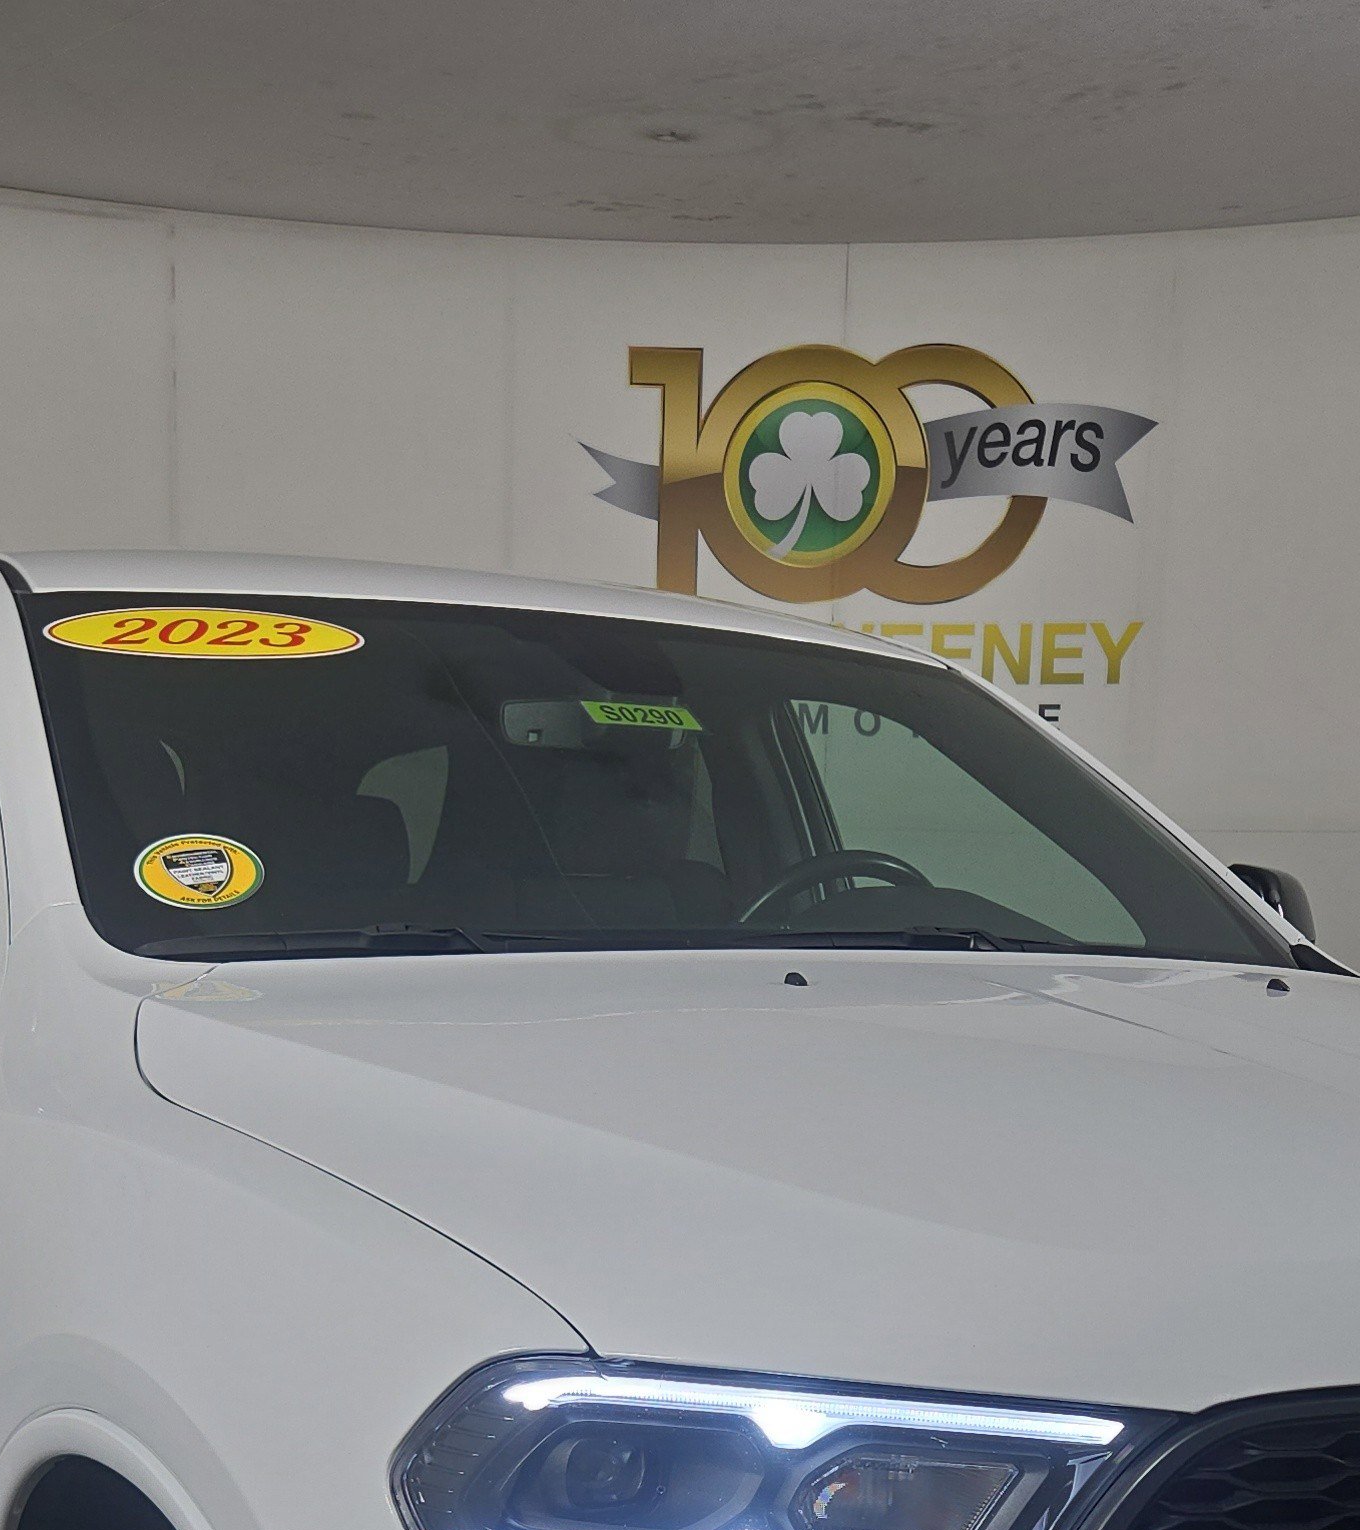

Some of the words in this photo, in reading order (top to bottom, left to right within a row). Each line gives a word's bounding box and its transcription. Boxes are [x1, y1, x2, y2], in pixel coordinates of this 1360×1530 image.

[941, 417, 1105, 488] years
[101, 617, 313, 649] 2023
[599, 705, 685, 726] S0290
